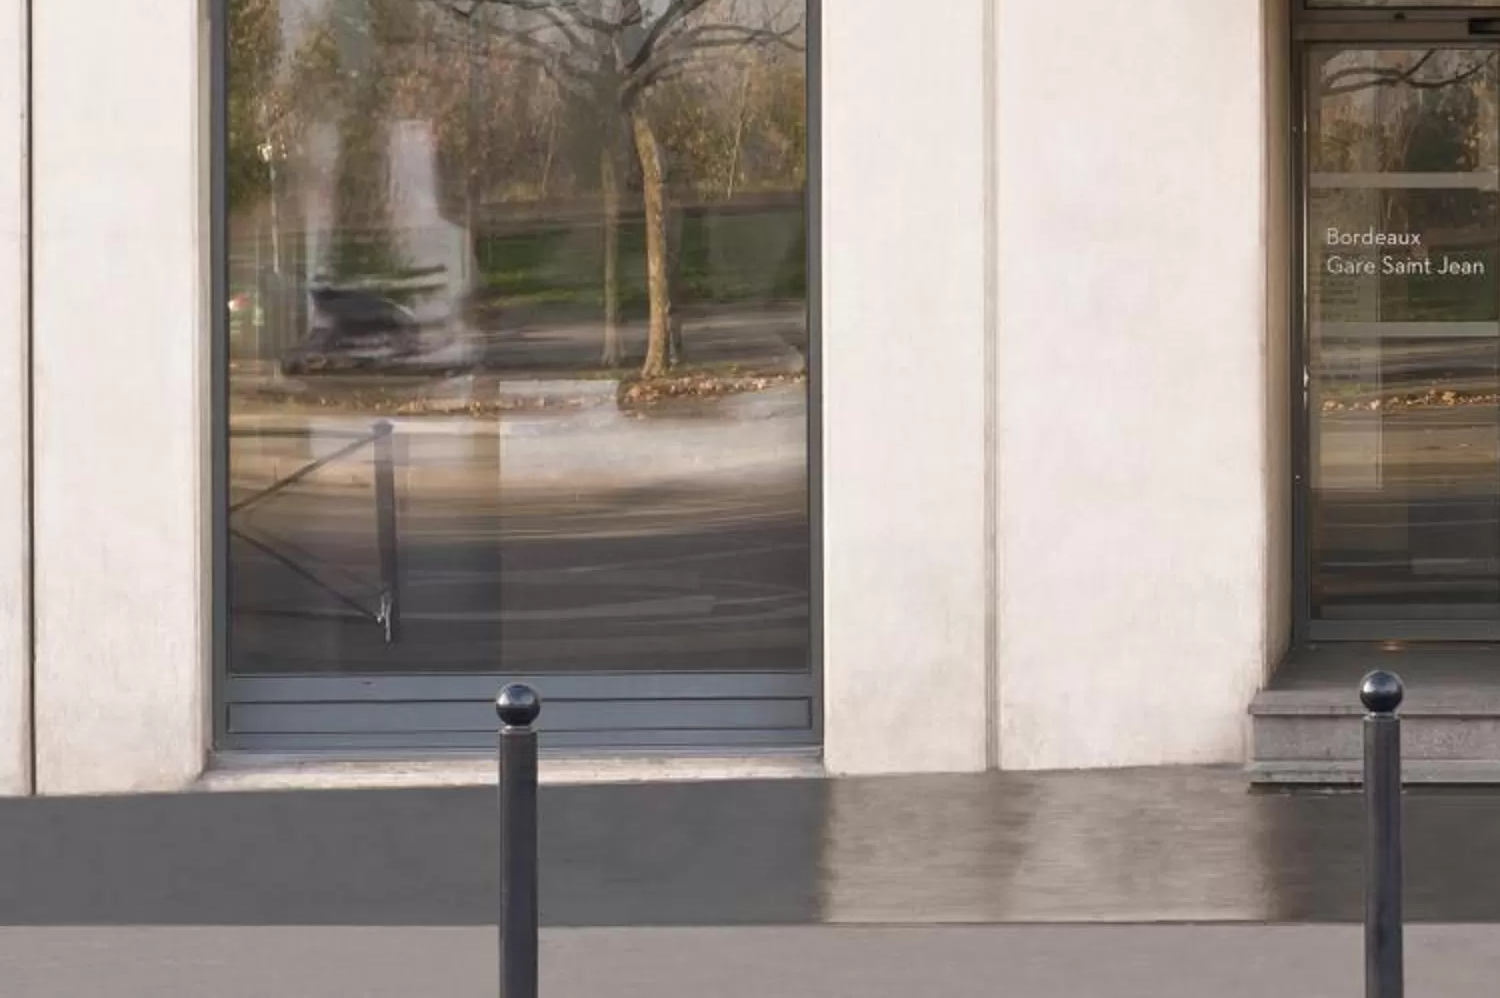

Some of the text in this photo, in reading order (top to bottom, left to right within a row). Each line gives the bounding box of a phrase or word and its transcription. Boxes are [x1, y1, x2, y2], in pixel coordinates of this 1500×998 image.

[1326, 226, 1422, 246] Bordeaux
[1326, 254, 1486, 275] Gare Saint Jean
